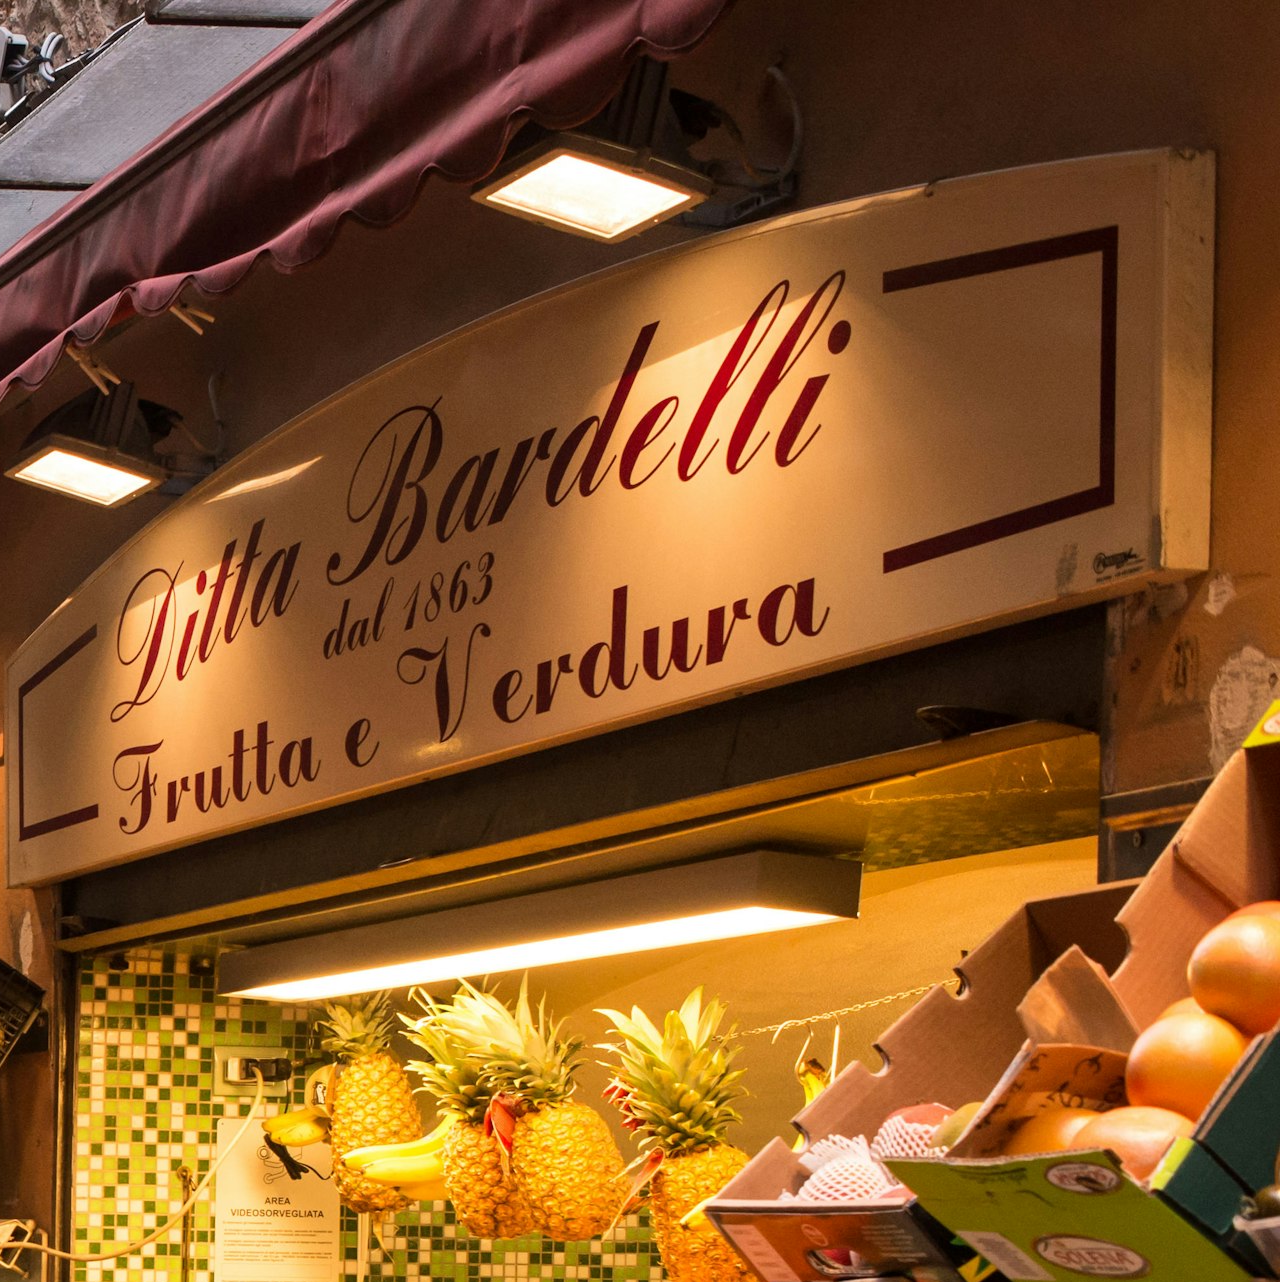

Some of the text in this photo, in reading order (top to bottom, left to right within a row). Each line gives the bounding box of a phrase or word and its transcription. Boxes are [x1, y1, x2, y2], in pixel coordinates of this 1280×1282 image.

[110, 270, 852, 723] Ditta Bardelli
[322, 551, 496, 660] dal 1863
[111, 578, 831, 836] Frutta e Verdura
[230, 1208, 325, 1219] VIDEOSORVEGLIATA
[264, 1197, 292, 1206] AREA
